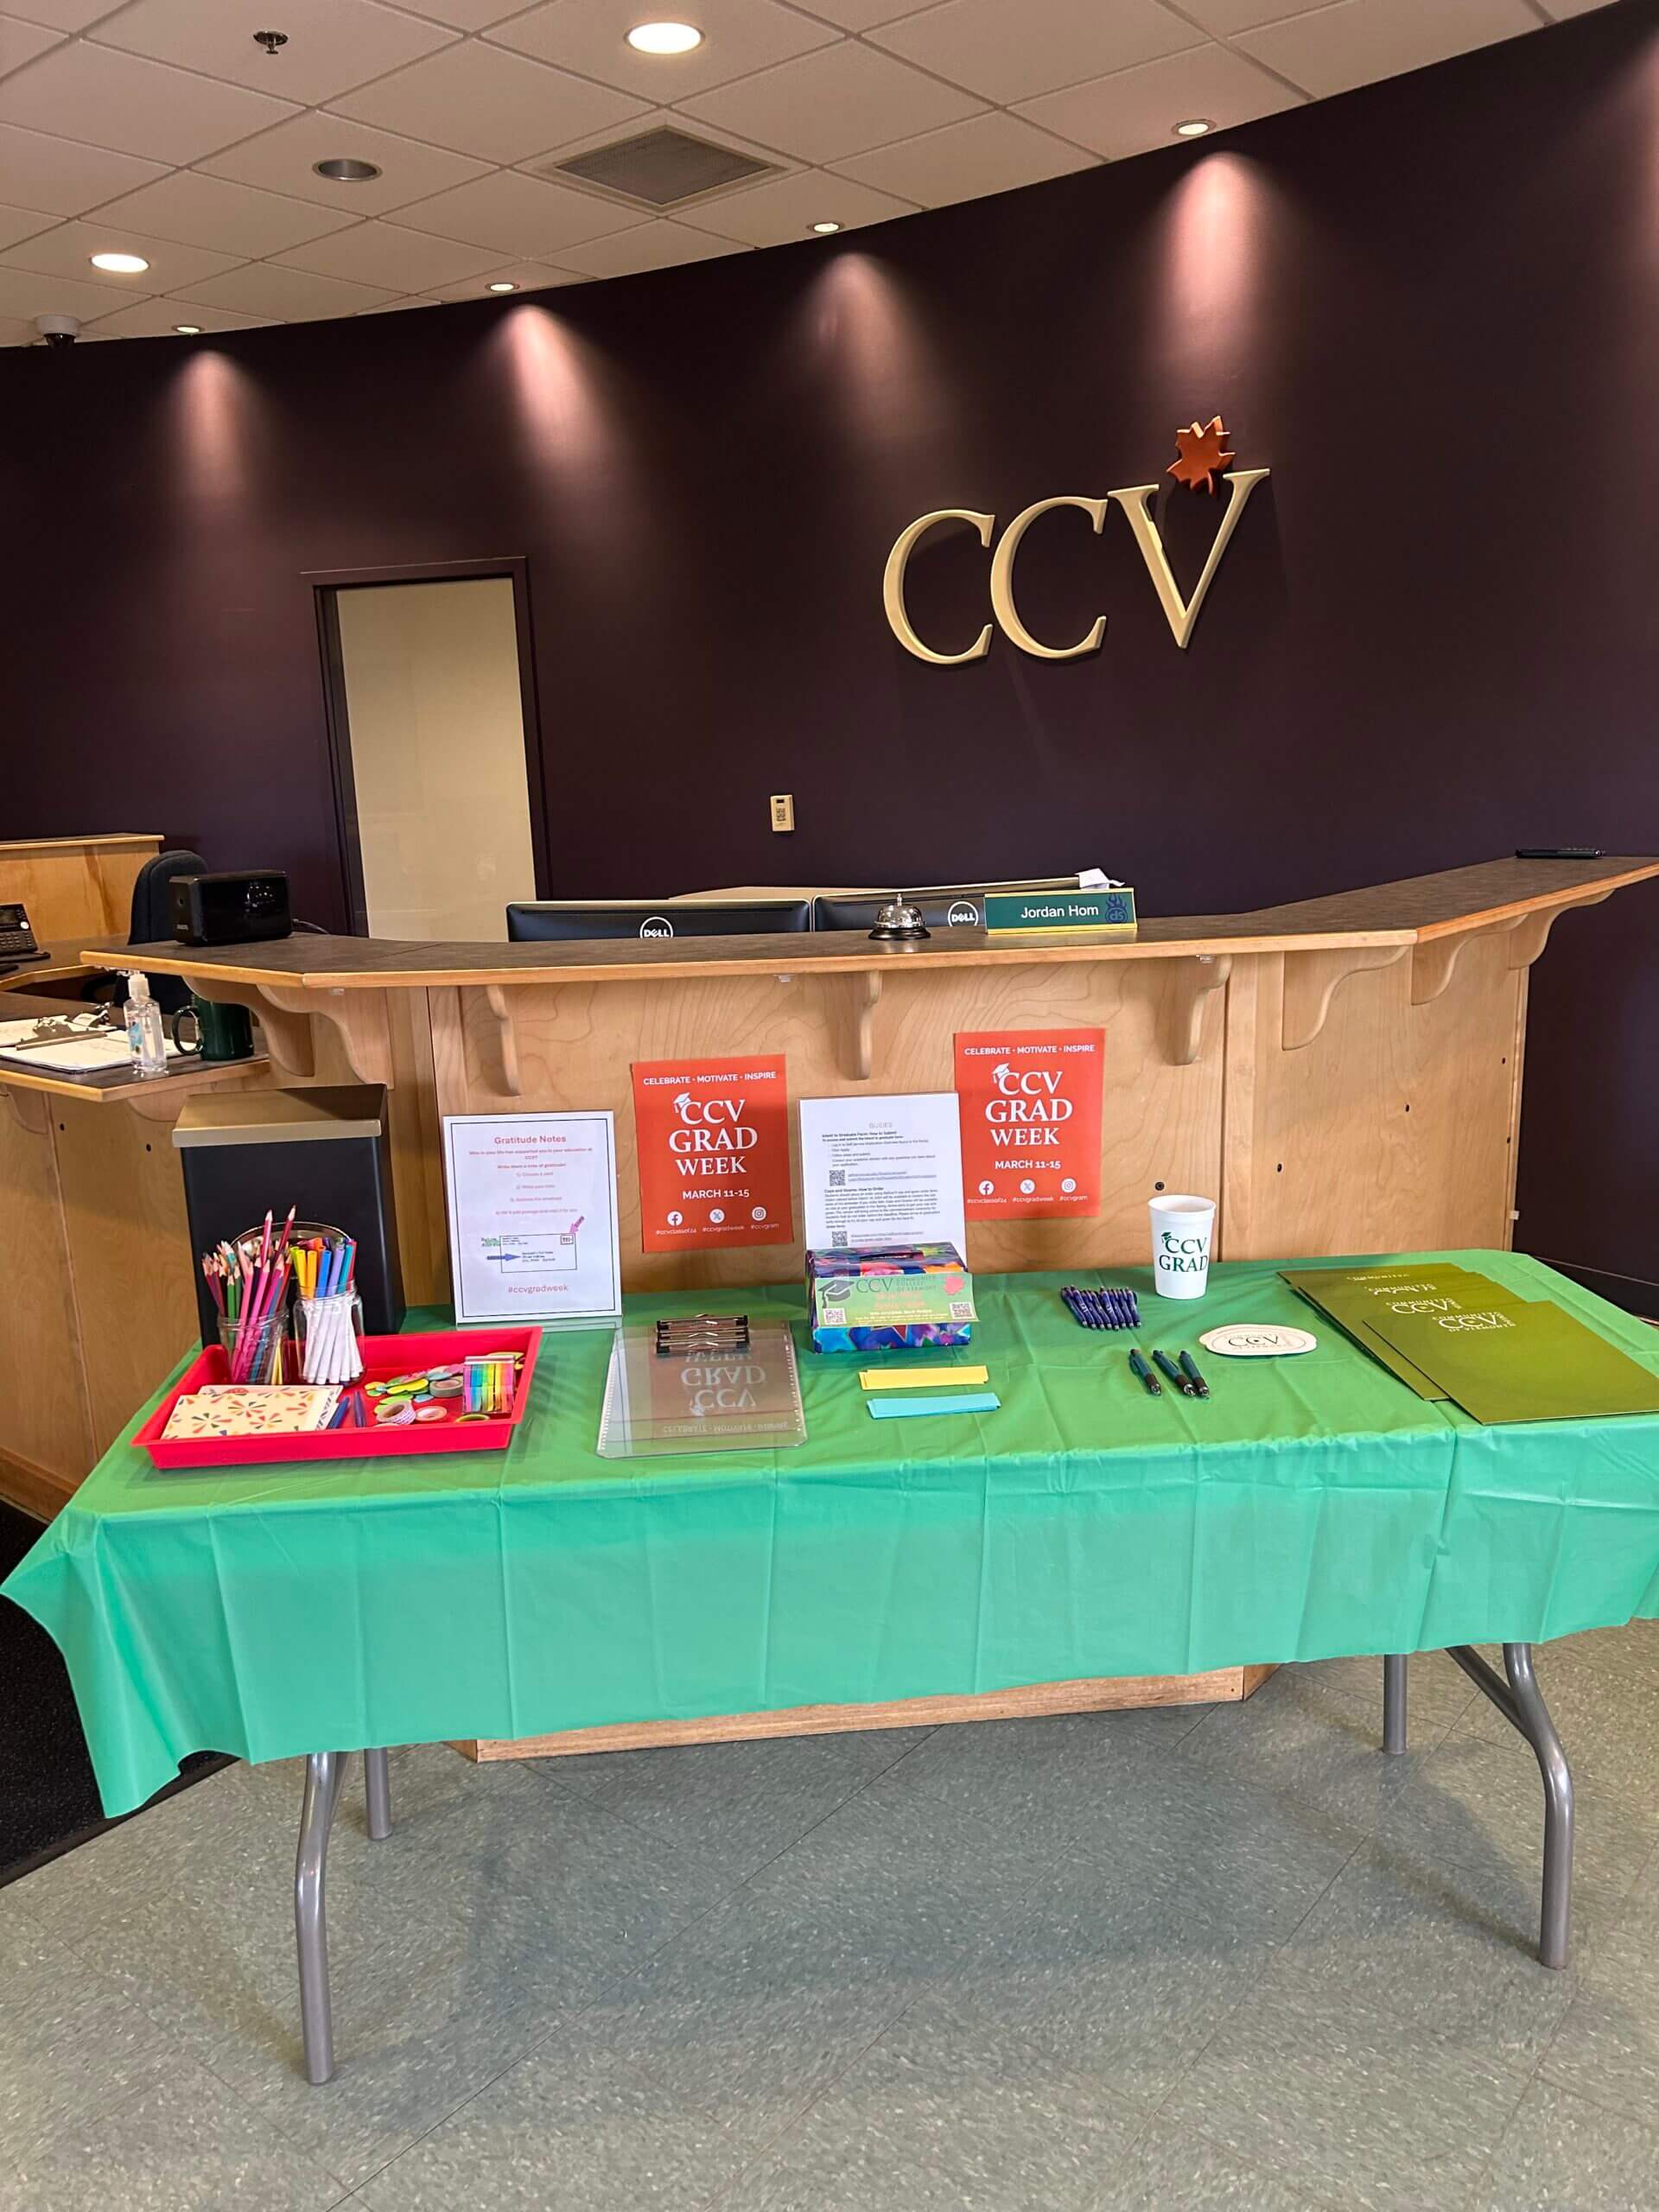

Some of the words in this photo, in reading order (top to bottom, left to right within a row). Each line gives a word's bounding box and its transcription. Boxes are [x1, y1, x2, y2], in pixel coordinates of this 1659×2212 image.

[883, 468, 1270, 664] CCV
[951, 912, 976, 922] DELL
[1020, 906, 1065, 919] Jordan
[1069, 905, 1099, 917] Hom
[644, 928, 671, 938] DELL
[1017, 1046, 1058, 1054] MOTIVATE
[1064, 1044, 1095, 1052] INSPIRE
[643, 1076, 691, 1085] CELEBRATE
[696, 1073, 739, 1083] MOTIVATE
[744, 1071, 777, 1080] INSPIRE
[998, 1071, 1063, 1096] CCV
[679, 1098, 747, 1125] CCV
[985, 1098, 1073, 1123] GRAD
[494, 1135, 537, 1145] Gratitude
[539, 1135, 567, 1143] Notes
[668, 1126, 759, 1154] GRAD
[990, 1127, 1060, 1147] WEEK
[674, 1156, 747, 1176] WEEK
[995, 1160, 1033, 1169] MARCH
[1036, 1160, 1061, 1169] 11-15
[683, 1190, 721, 1200] MARCH
[723, 1189, 750, 1198] 11-15
[1165, 1236, 1208, 1254] CCV
[1159, 1254, 1208, 1272] GRAD
[508, 1284, 569, 1294] #ccvgradweek
[855, 1278, 893, 1294] CCV
[1391, 1300, 1450, 1314] CCV
[1438, 1314, 1498, 1329] CCV
[1228, 1335, 1279, 1347] CCV
